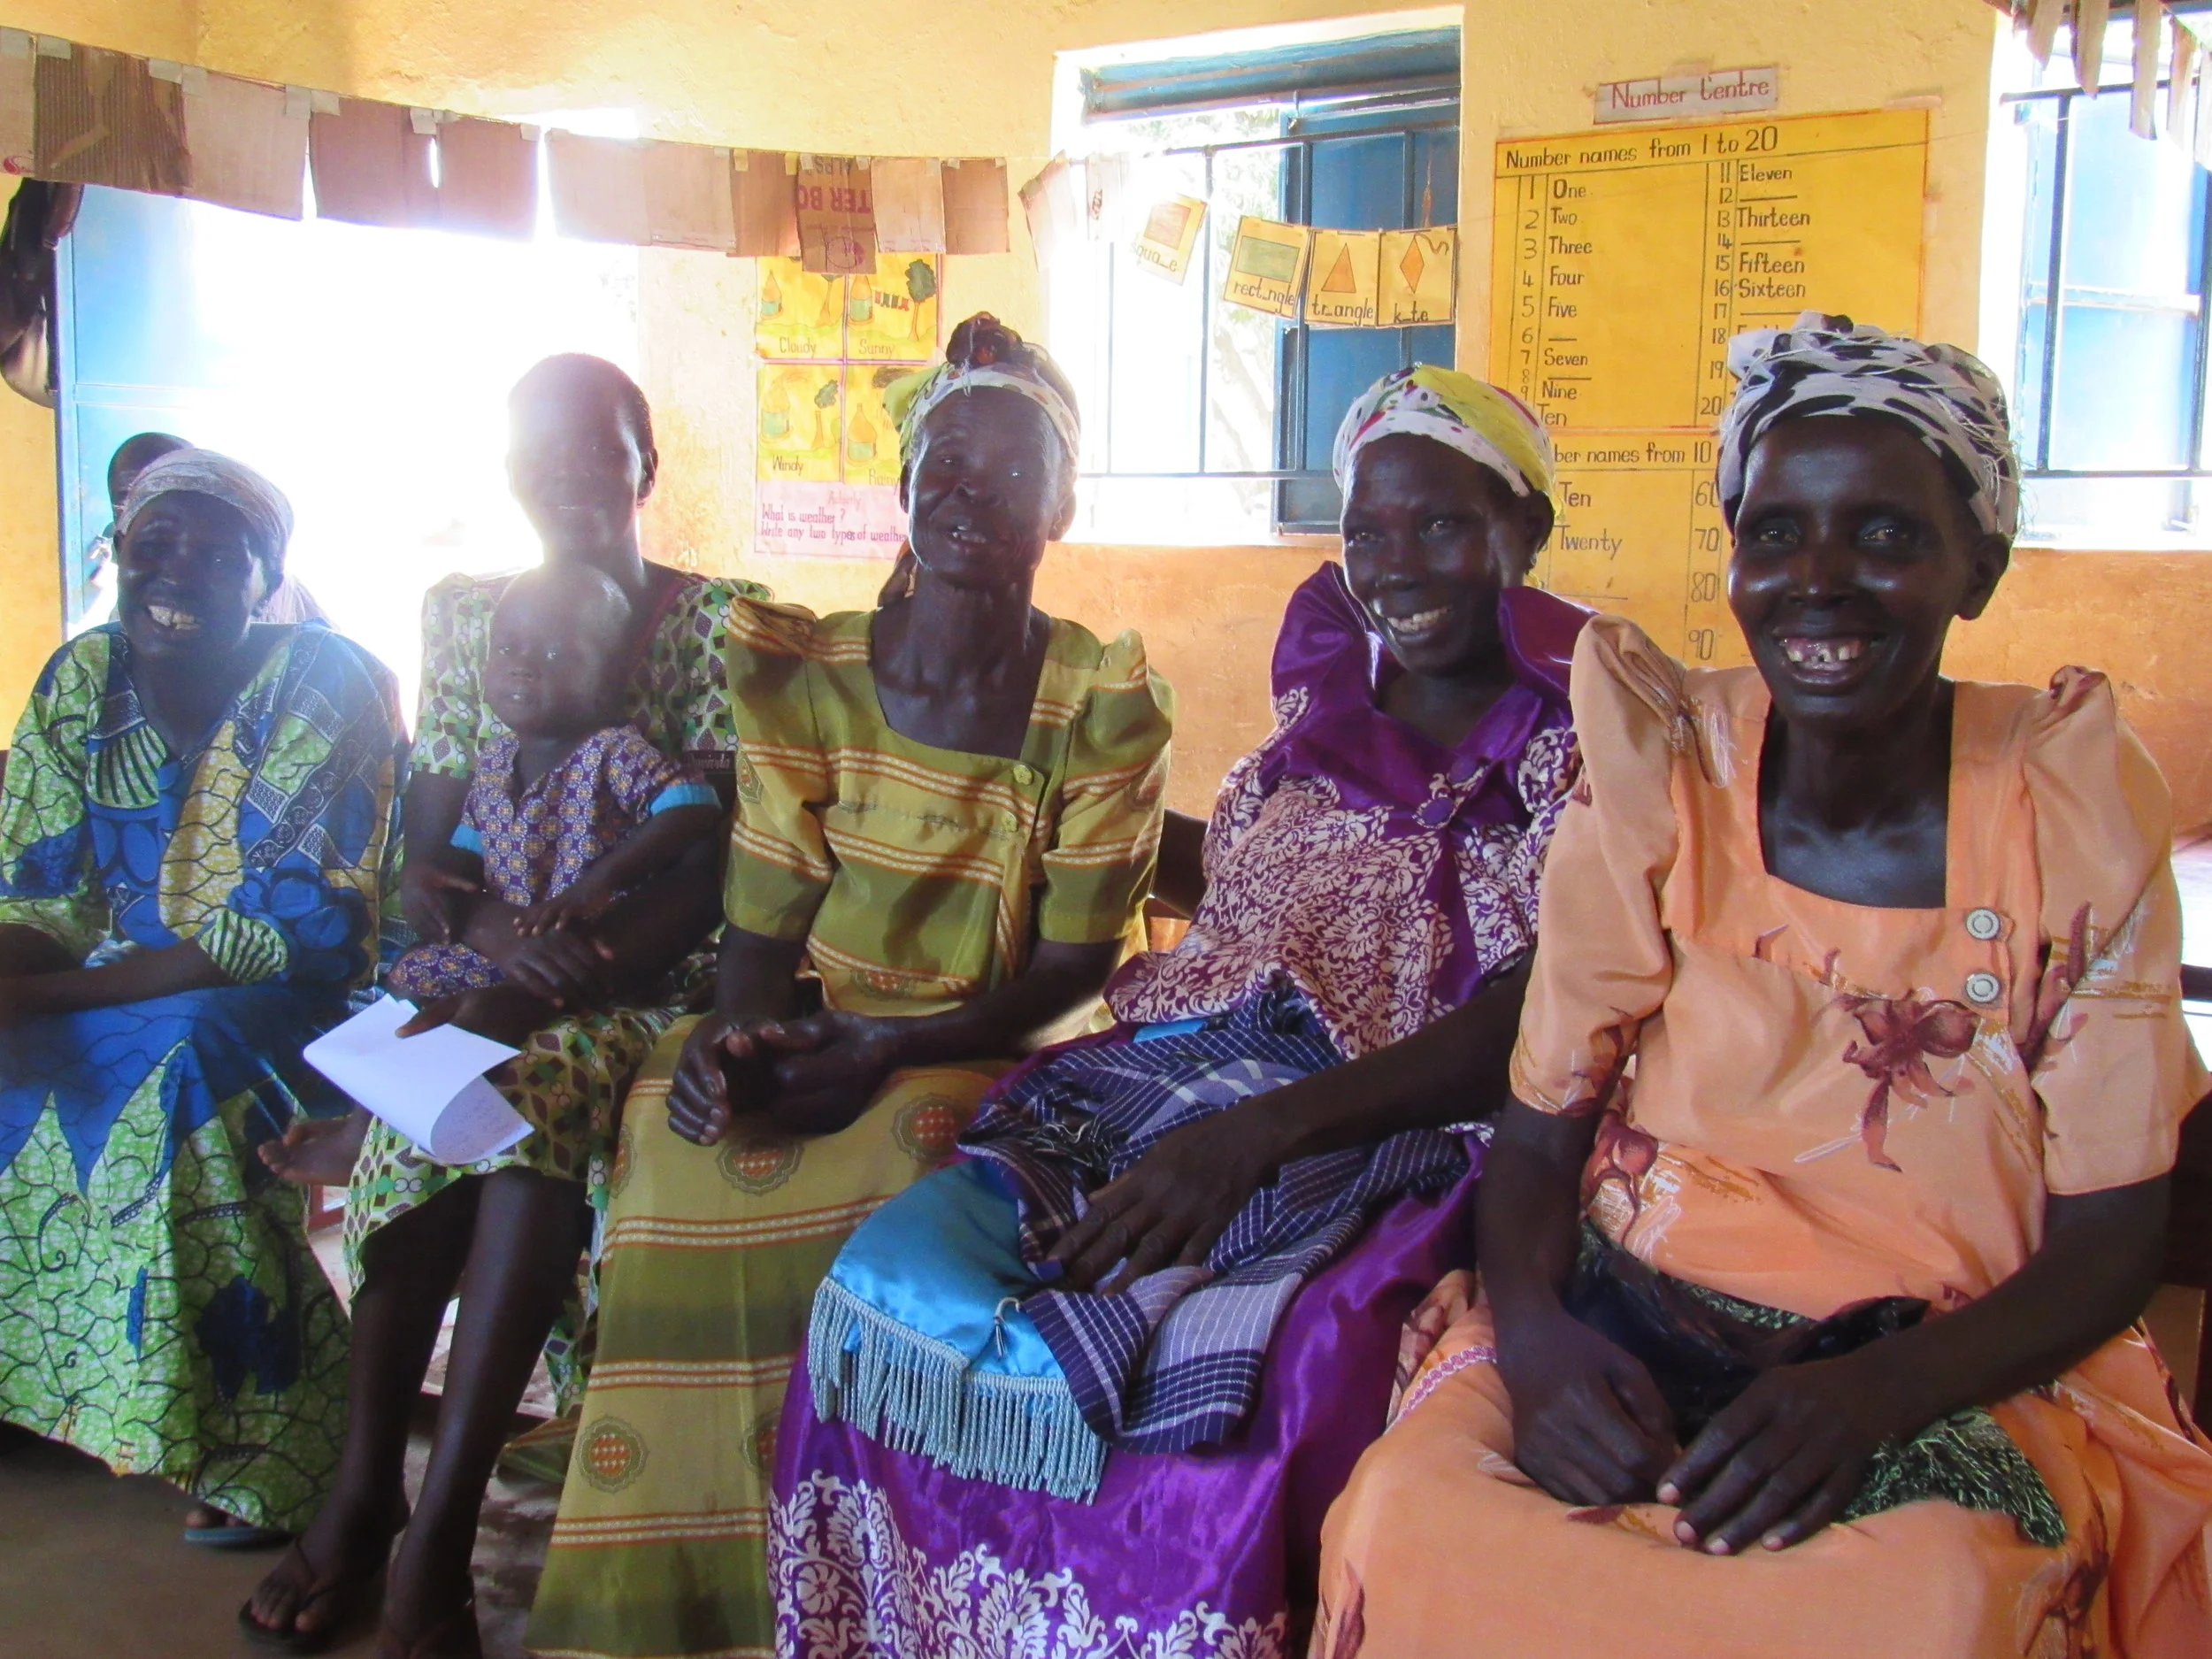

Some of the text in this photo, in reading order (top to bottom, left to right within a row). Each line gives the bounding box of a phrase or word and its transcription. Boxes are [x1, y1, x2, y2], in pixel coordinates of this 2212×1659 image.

[1611, 70, 1770, 110] Number Centre
[1506, 146, 1571, 169] Number
[1578, 145, 1638, 165] names
[1648, 137, 1692, 159] from
[1717, 133, 1740, 154] to
[1744, 125, 1778, 153] 20
[1720, 161, 1793, 184] 11 Eleven
[1530, 176, 1586, 200] 1 One
[1718, 187, 1733, 204] 12
[829, 187, 872, 214] TER
[1525, 206, 1578, 229] 2 Two
[1717, 205, 1810, 228] 13 Thirteen
[1523, 235, 1593, 260] 3 Three
[1717, 233, 1732, 250] 14
[1715, 250, 1806, 274] 15 Fifteen
[1522, 265, 1585, 288] 4 Four
[1714, 276, 1807, 299] 16 Sixteen
[1521, 295, 1578, 319] 5 Five
[1713, 303, 1728, 319] 17
[1521, 326, 1534, 344] 6
[1712, 327, 1727, 345] 18
[779, 336, 817, 359] Cloudy
[858, 338, 895, 359] Sunny
[1520, 347, 1588, 366] 7 Seven
[1522, 368, 1531, 384] 8
[1709, 360, 1724, 380] 19
[1520, 380, 1578, 402] 9 Nine
[1536, 403, 1568, 426] Ten
[1699, 396, 1723, 417] 20
[1554, 440, 1712, 464] ber names from 10
[772, 455, 804, 477] Windy
[1558, 480, 1592, 508] Ten
[762, 502, 785, 522] What
[787, 509, 796, 522] is
[799, 505, 835, 525] weather
[787, 527, 804, 542] any
[810, 523, 826, 540] two
[856, 523, 868, 541] of
[1553, 524, 1721, 562] Twenty 70
[1690, 571, 1717, 603] 80
[1687, 628, 1715, 661] 90
